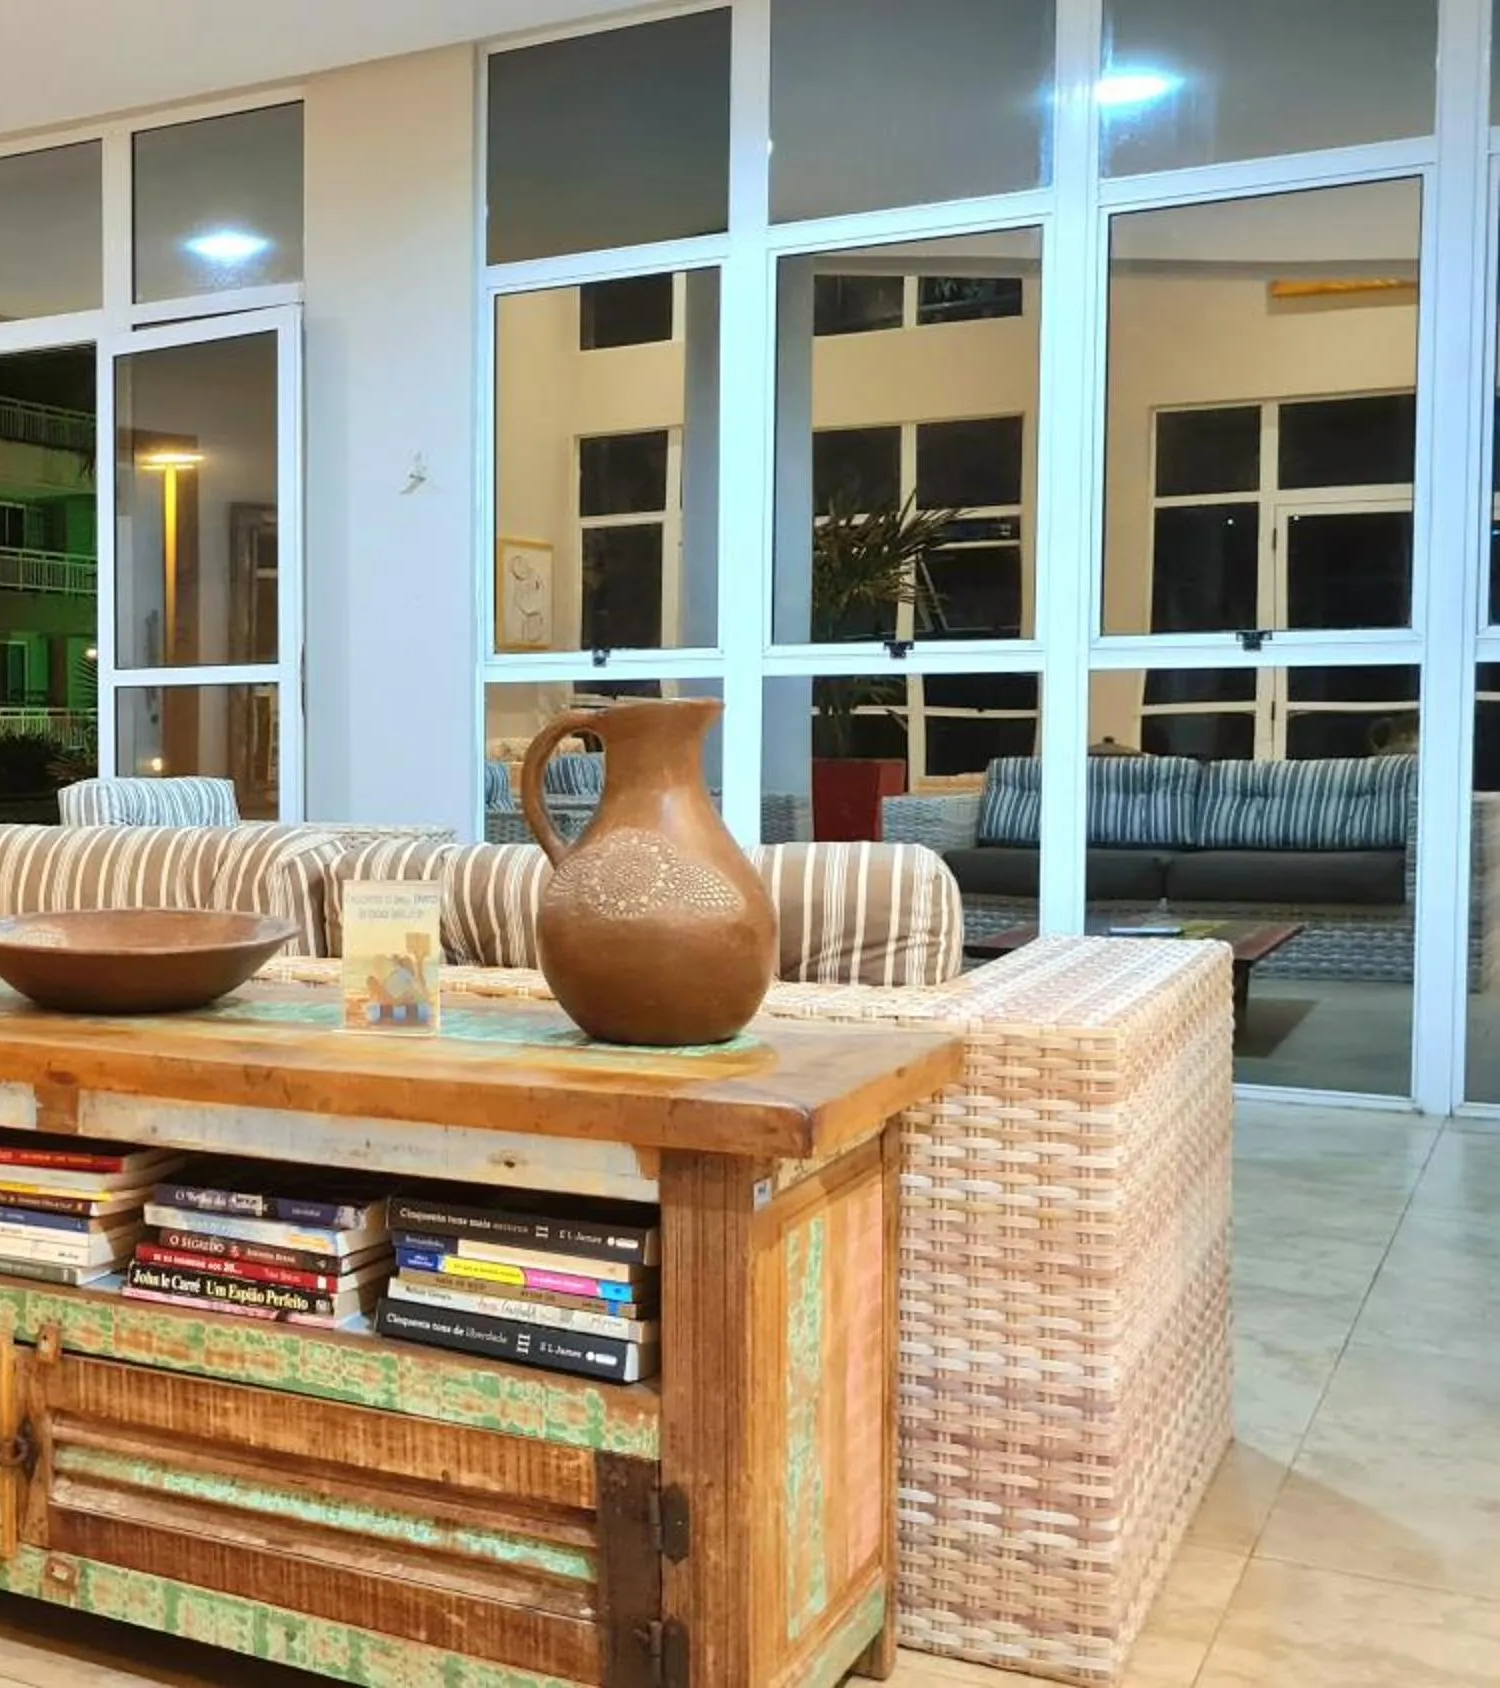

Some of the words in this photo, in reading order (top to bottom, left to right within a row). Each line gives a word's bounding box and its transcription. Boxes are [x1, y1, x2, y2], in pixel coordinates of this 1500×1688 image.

[169, 1235, 180, 1246] O
[133, 1269, 160, 1286] John
[161, 1272, 171, 1288] le
[172, 1275, 202, 1293] Carré
[206, 1280, 226, 1297] Um
[228, 1284, 265, 1303] Espião
[266, 1289, 309, 1310] Perfeito
[386, 1312, 431, 1329] Cinquenta
[452, 1325, 465, 1336] de
